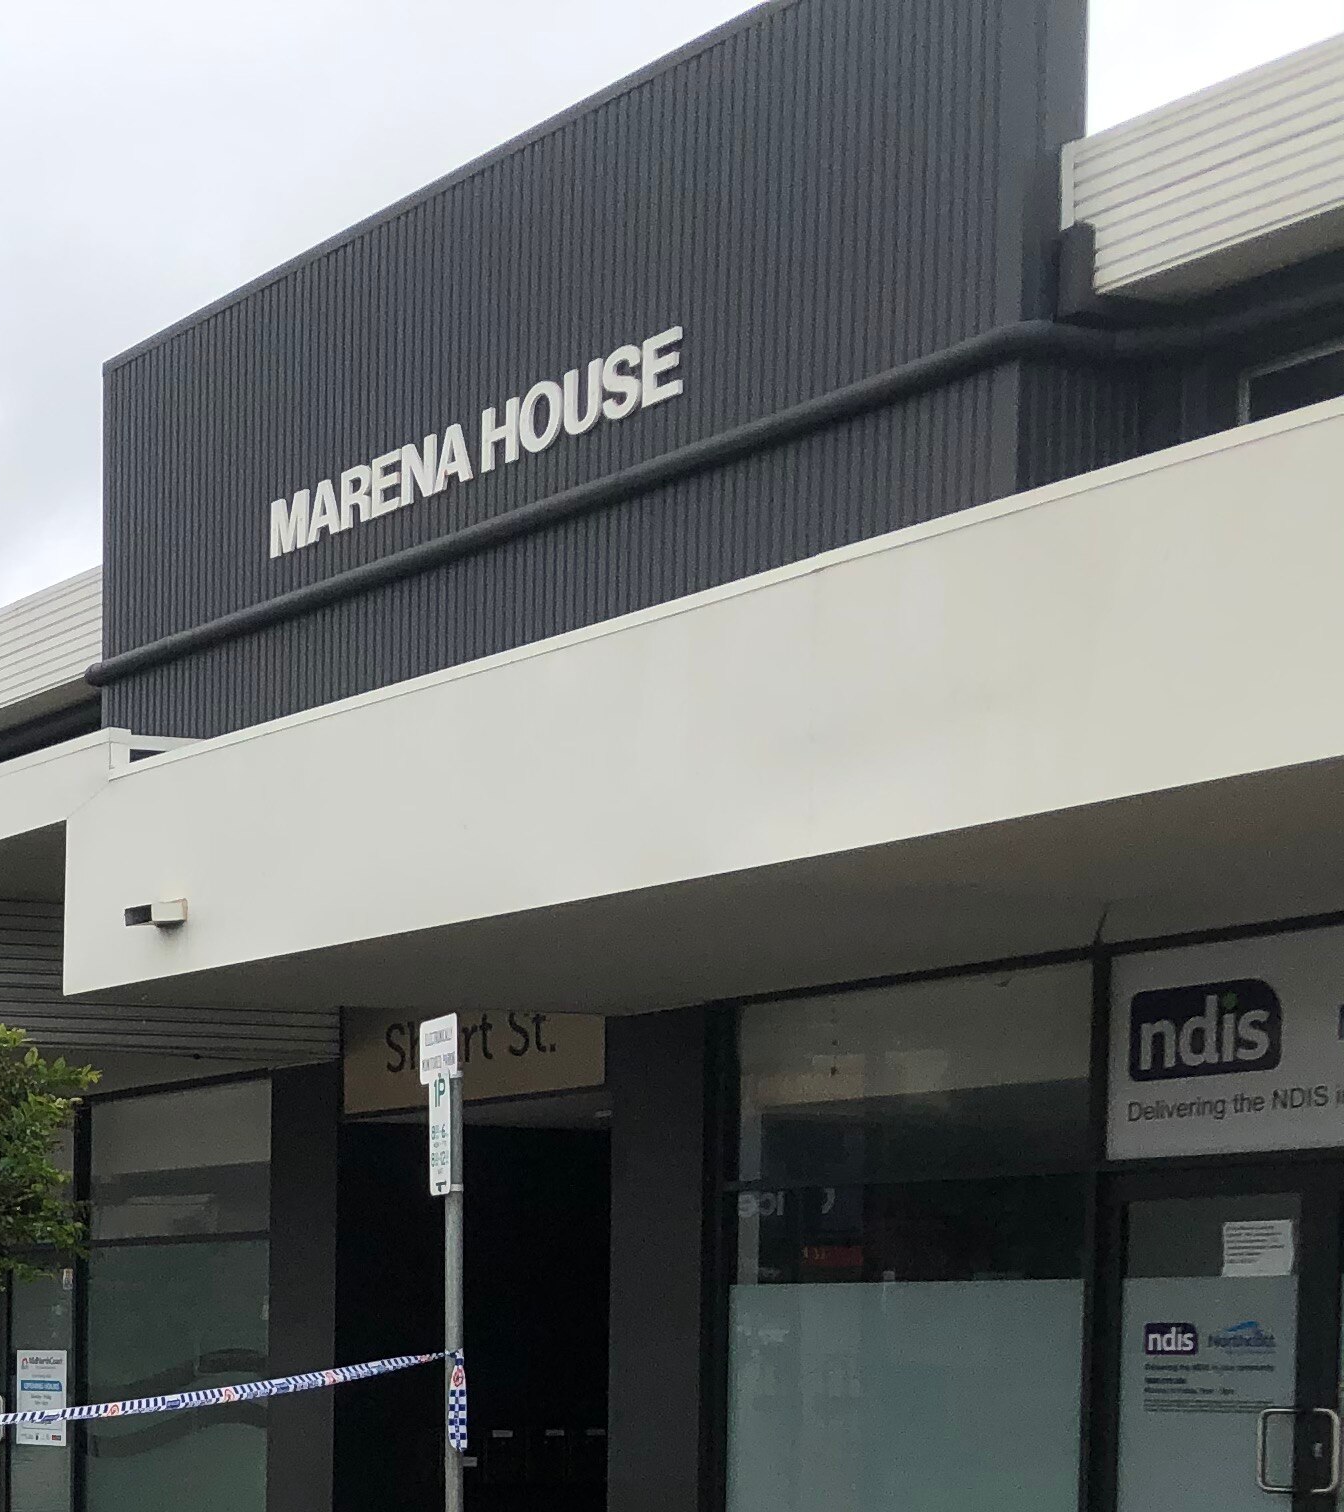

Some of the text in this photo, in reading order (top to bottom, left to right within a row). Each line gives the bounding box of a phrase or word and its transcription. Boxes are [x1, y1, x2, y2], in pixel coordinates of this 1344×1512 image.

[270, 325, 684, 559] MARENA HOUSE
[386, 1011, 556, 1073] Srt St.
[1140, 991, 1270, 1071] ndis
[1128, 1096, 1227, 1121] Delivering
[1233, 1093, 1265, 1113] the
[1271, 1085, 1329, 1110] NDIS
[1148, 1327, 1194, 1351] ndis
